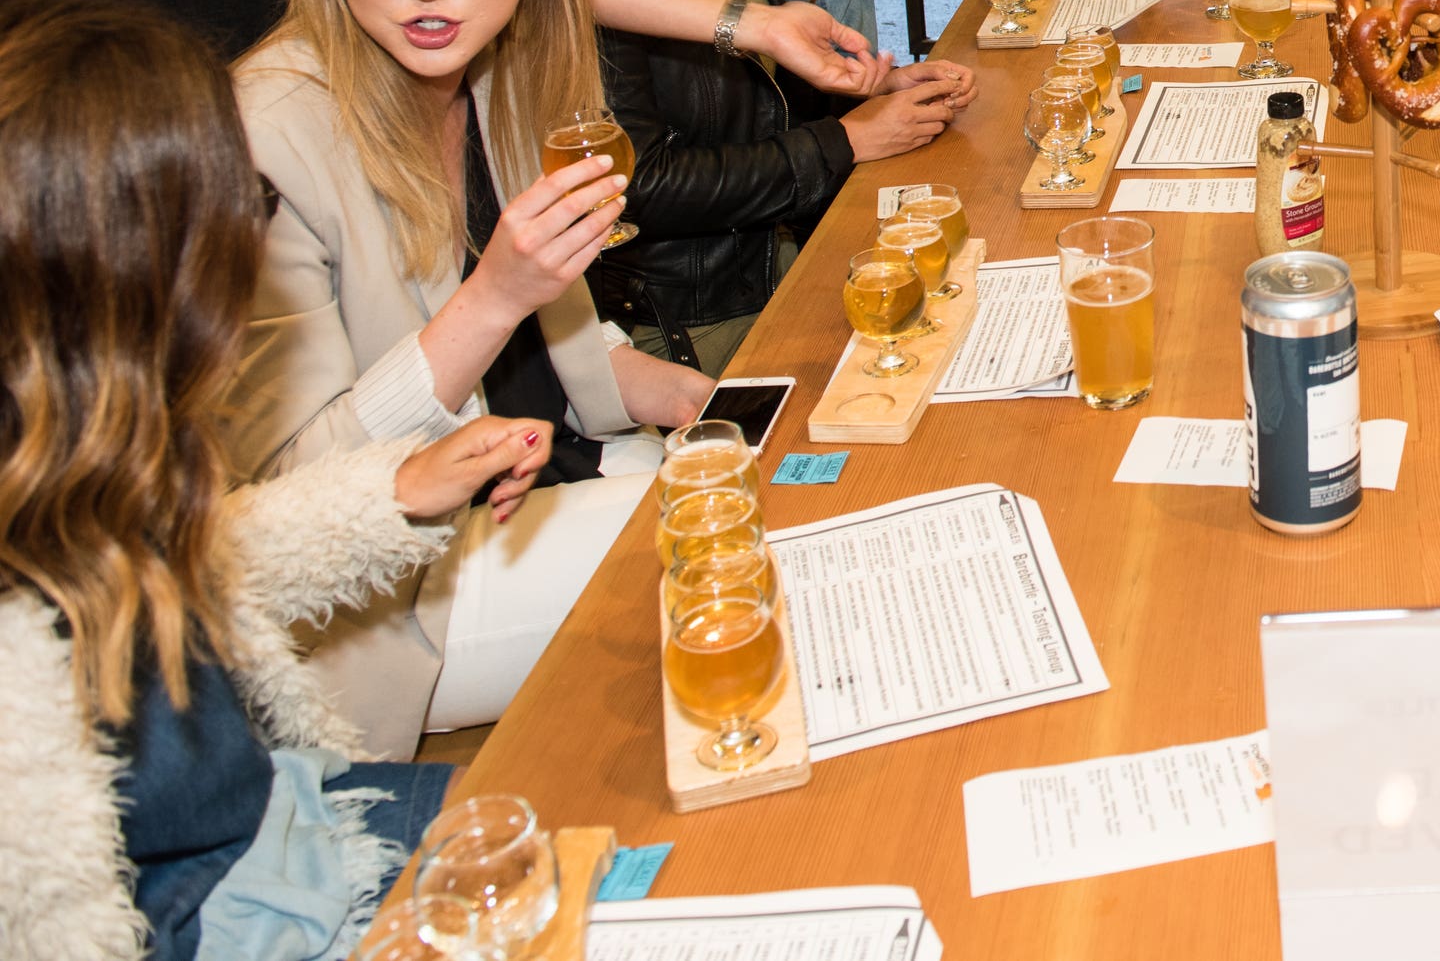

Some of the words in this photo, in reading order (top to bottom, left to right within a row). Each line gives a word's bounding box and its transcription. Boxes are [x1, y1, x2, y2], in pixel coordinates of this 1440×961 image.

[1286, 208, 1304, 218] Stone
[1012, 552, 1038, 600] Barebottle
[1031, 606, 1053, 643] Tasting
[1043, 640, 1064, 675] Lineup
